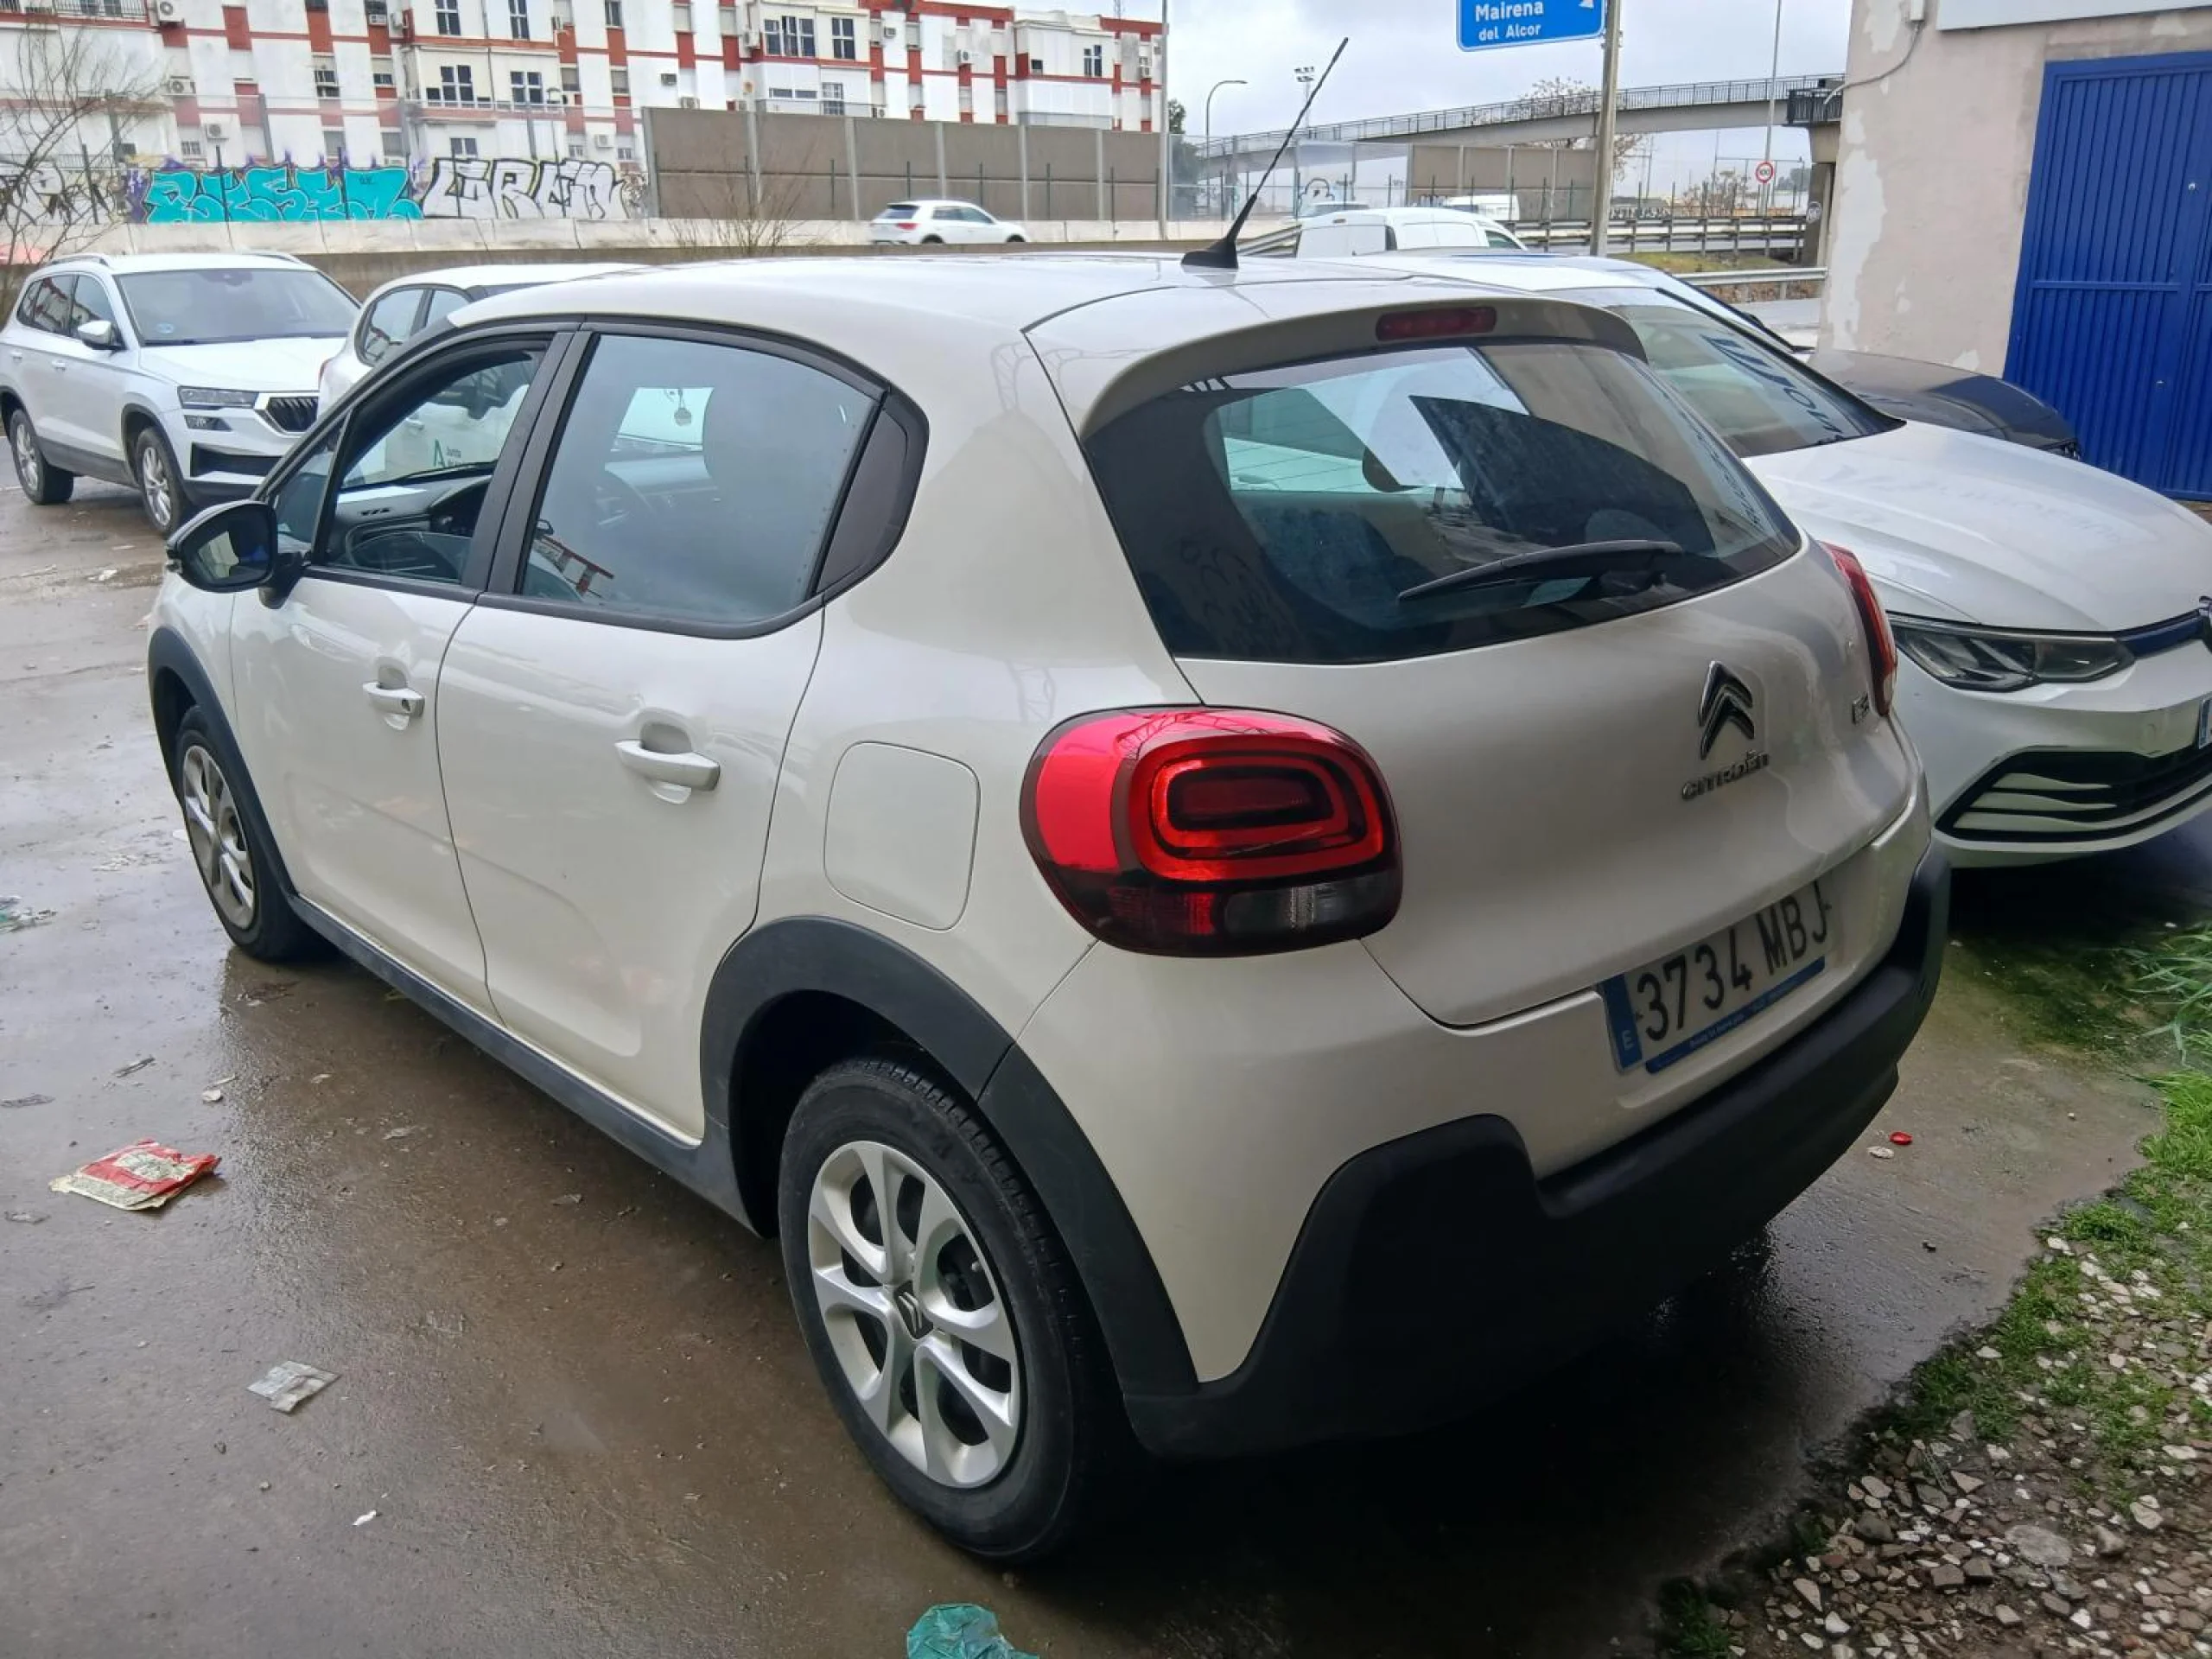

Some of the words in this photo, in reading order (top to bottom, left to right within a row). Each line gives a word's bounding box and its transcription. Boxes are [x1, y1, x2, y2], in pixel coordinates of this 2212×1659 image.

[1475, 2, 1544, 22] Mairena
[1478, 27, 1499, 41] del
[1505, 23, 1541, 39] Alcor
[1637, 927, 1752, 1042] 3734
[1756, 880, 1828, 976] MBJ
[1622, 1029, 1633, 1051] E
